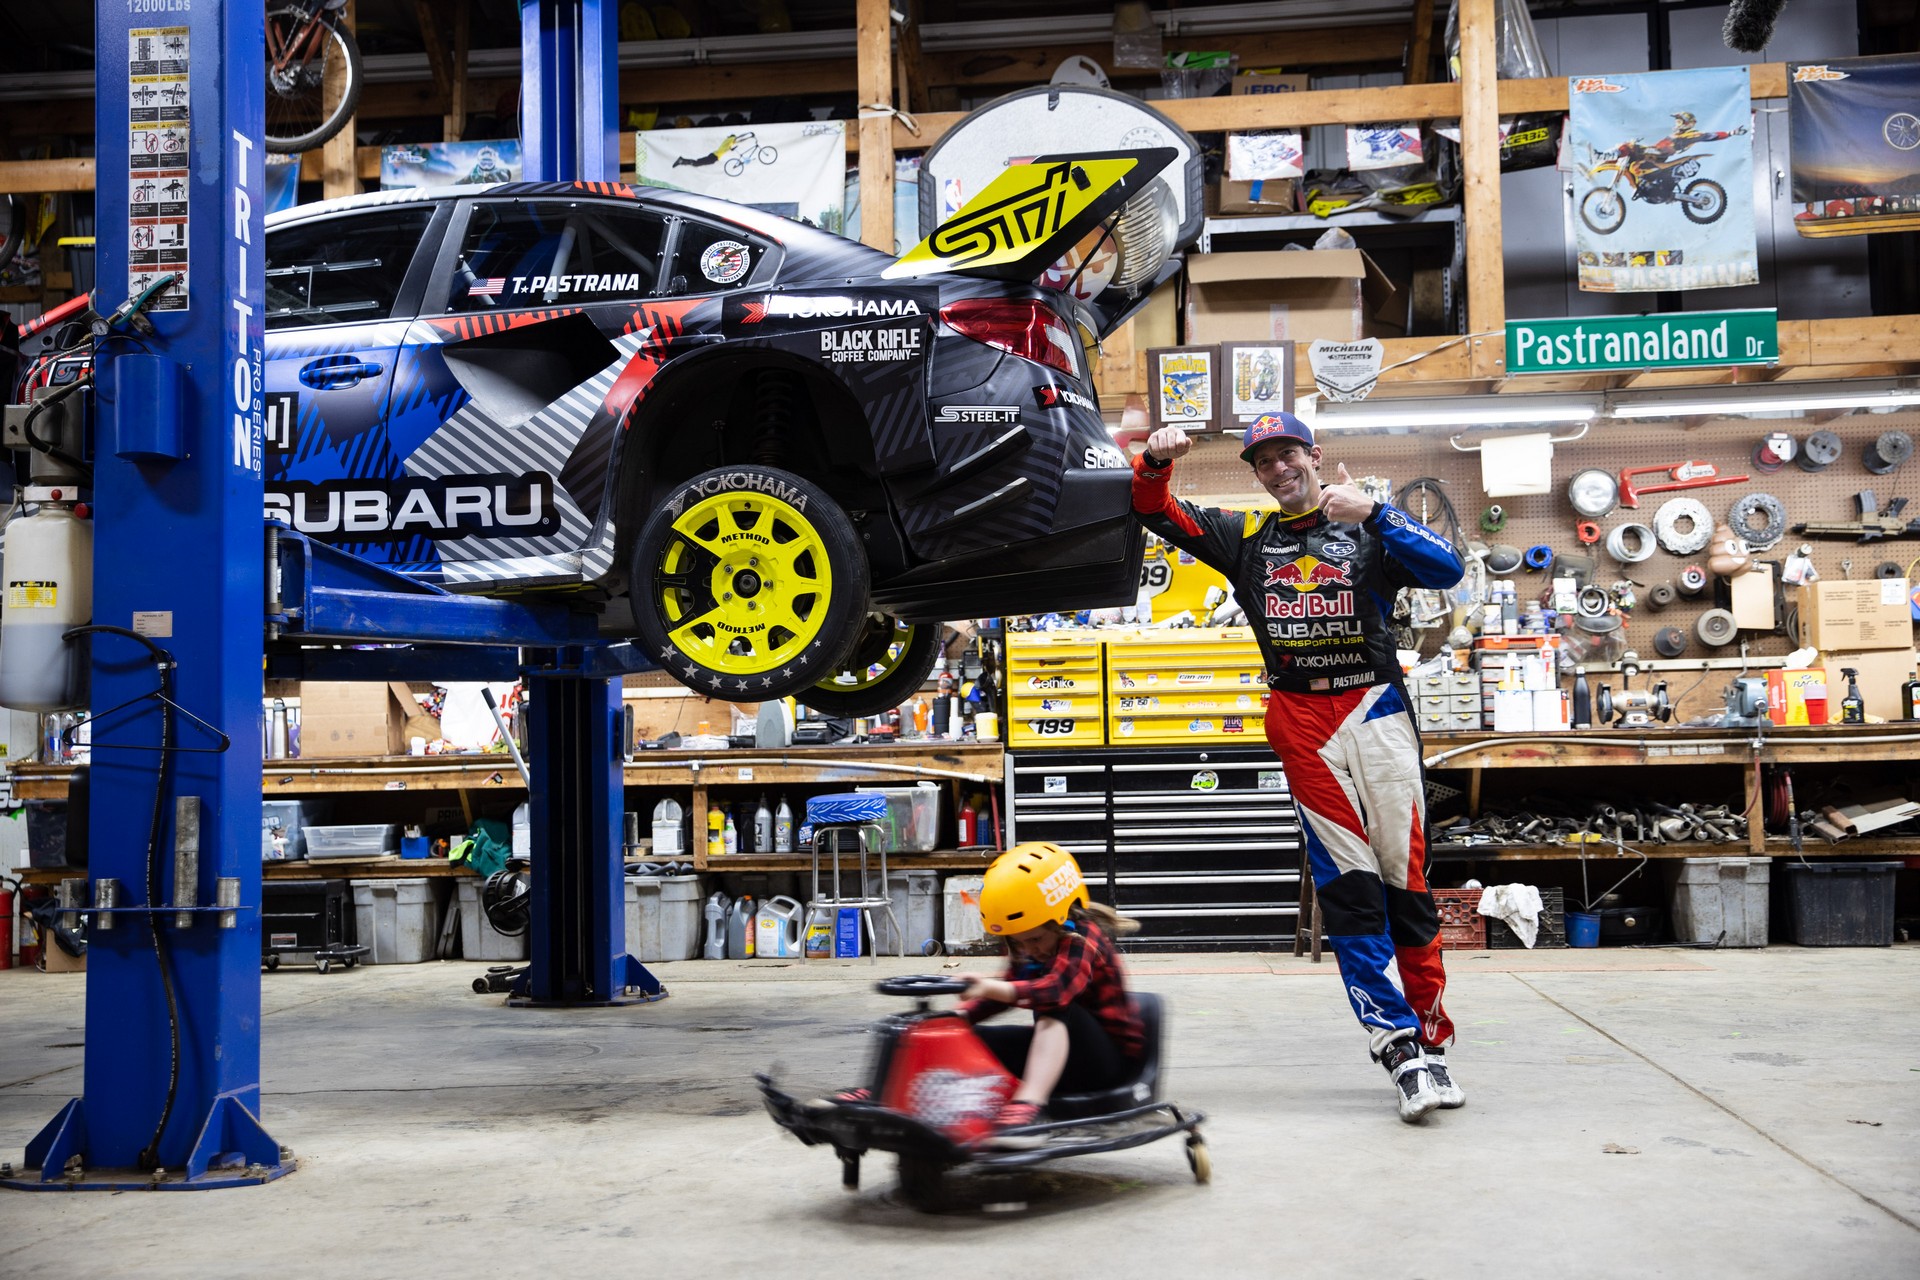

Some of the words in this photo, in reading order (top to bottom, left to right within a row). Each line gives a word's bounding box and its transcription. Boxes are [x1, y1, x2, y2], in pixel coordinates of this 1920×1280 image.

[233, 130, 253, 470] TRITON
[821, 330, 873, 351] BLACK
[878, 329, 920, 349] RIFLE
[1319, 345, 1373, 353] MICHELIN
[1517, 319, 1728, 366] Pastranaland
[1746, 337, 1764, 357] Dr
[831, 351, 864, 363] COFFEE
[868, 349, 912, 361] COMPANY
[253, 348, 262, 393] PRO
[1060, 389, 1096, 412] YOKOHAMA
[961, 410, 1018, 423] STEEL-IT
[691, 473, 809, 512] YOKOHAMA
[721, 532, 770, 545] METHOD
[1406, 523, 1452, 554] SUBARU
[1265, 592, 1306, 618] Red
[1307, 590, 1354, 616] Bull
[717, 621, 766, 634] METHOD
[1267, 620, 1361, 639] SUBARU
[1271, 638, 1340, 648] MOTORSPORTS
[1343, 636, 1364, 645] USA
[1294, 653, 1363, 668] YOKOHAMA
[1333, 671, 1375, 689] PASTRANA
[1035, 719, 1075, 734] 199
[1037, 861, 1075, 895] NITRO
